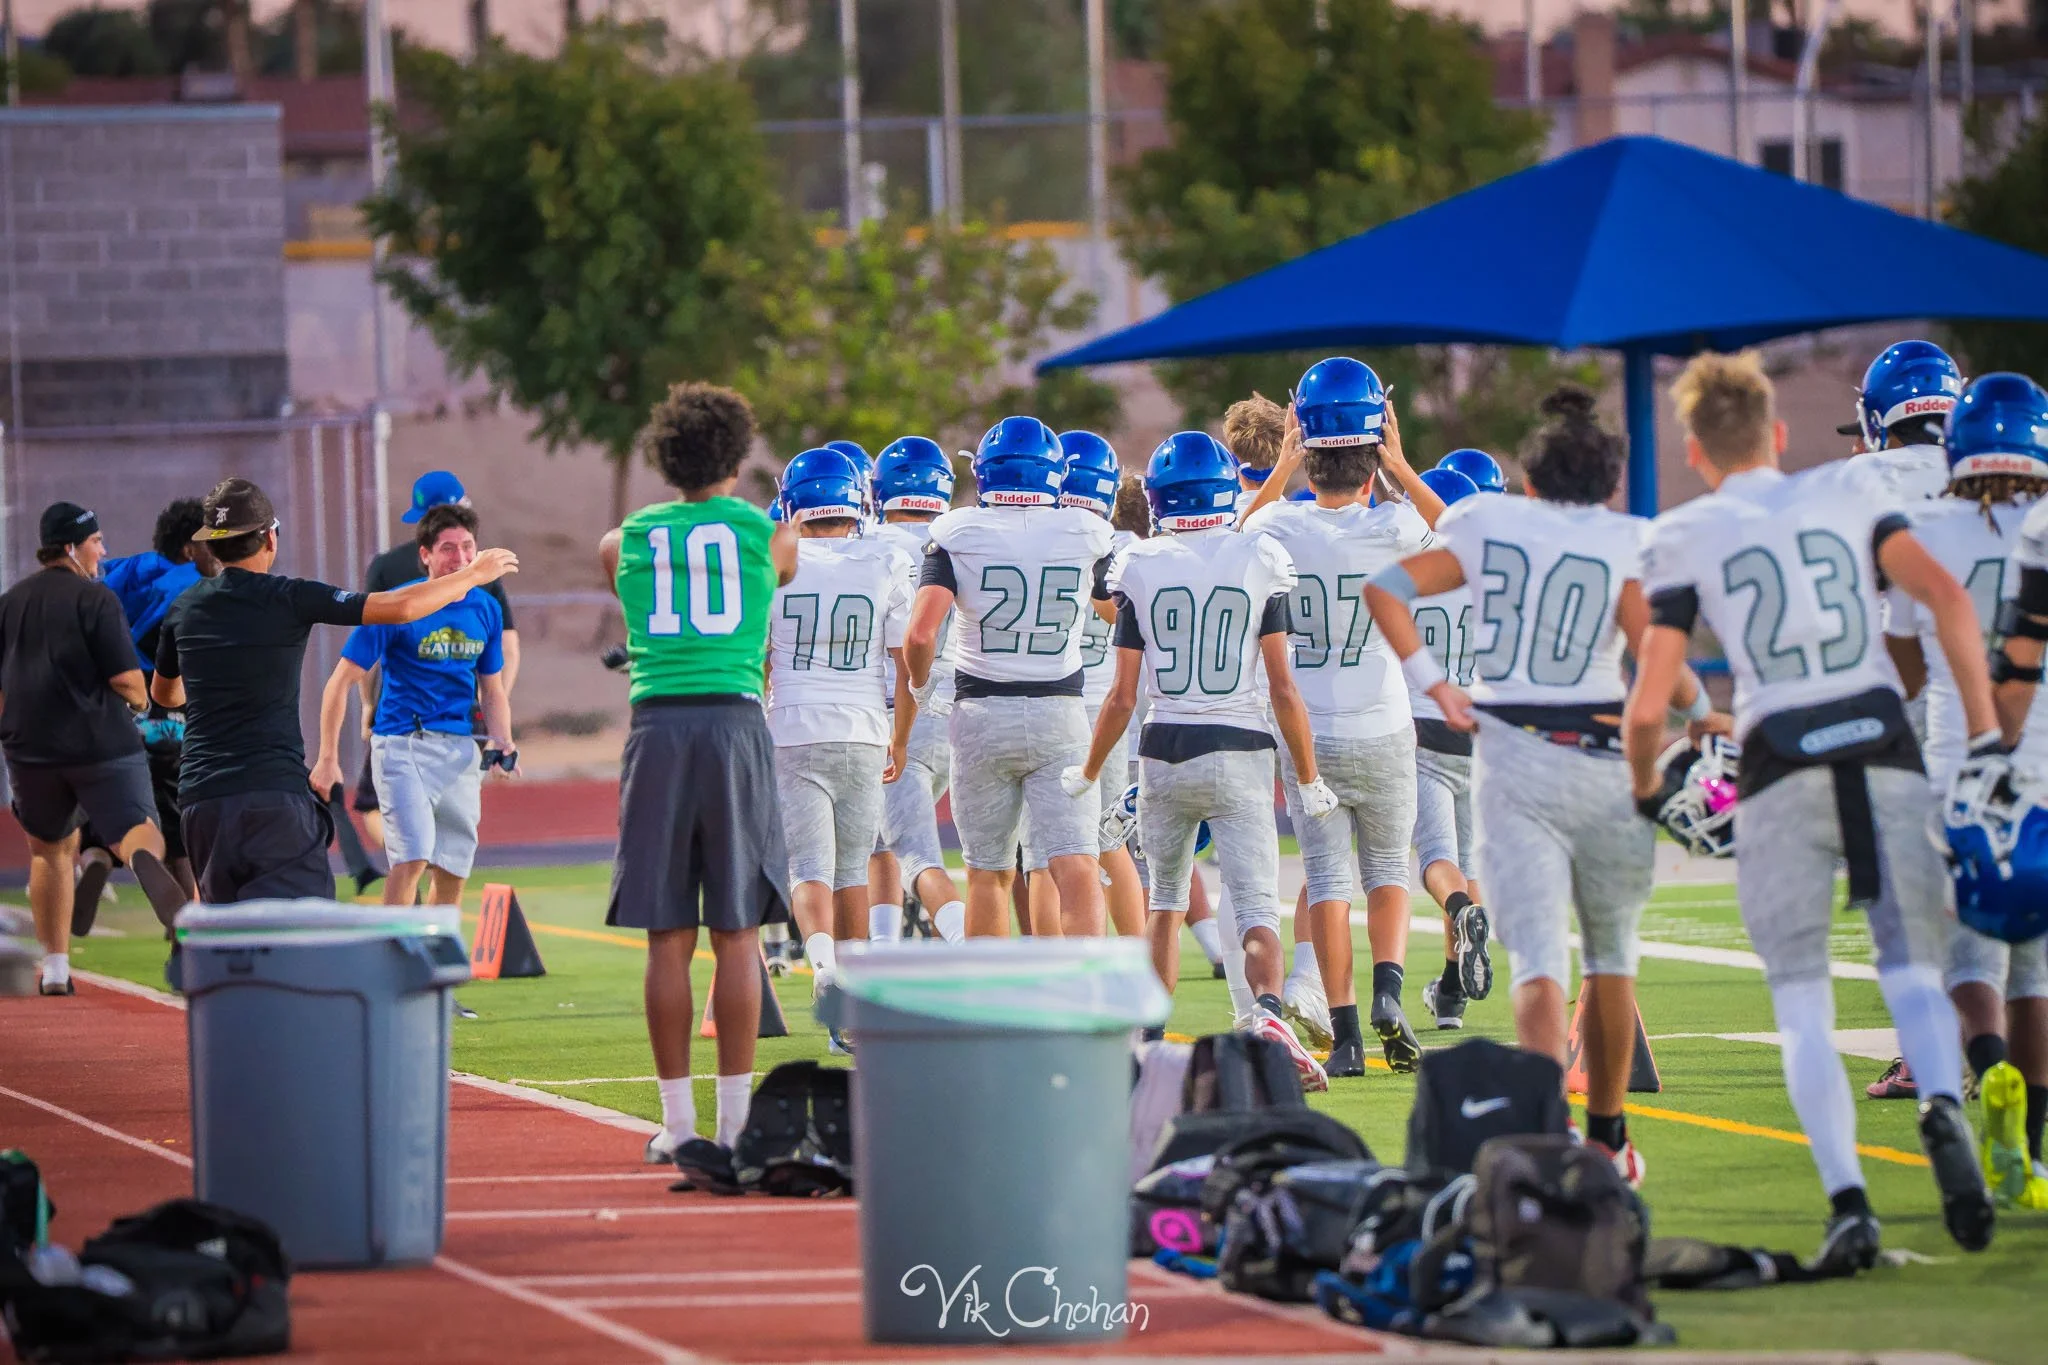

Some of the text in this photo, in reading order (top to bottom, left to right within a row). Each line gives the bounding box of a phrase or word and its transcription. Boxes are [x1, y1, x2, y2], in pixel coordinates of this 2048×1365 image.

[1320, 436, 1361, 446] Riddell
[1904, 399, 1953, 415] Riddel
[900, 498, 942, 510] Riddell
[993, 493, 1040, 504] Riddell
[1176, 515, 1223, 528] Riddell
[647, 521, 744, 637] 10
[979, 565, 1081, 657] 25
[1288, 573, 1370, 669] 97
[1474, 538, 1610, 687] 30
[1722, 528, 1869, 686] 23
[782, 593, 875, 671] 70
[1151, 585, 1251, 696] 90
